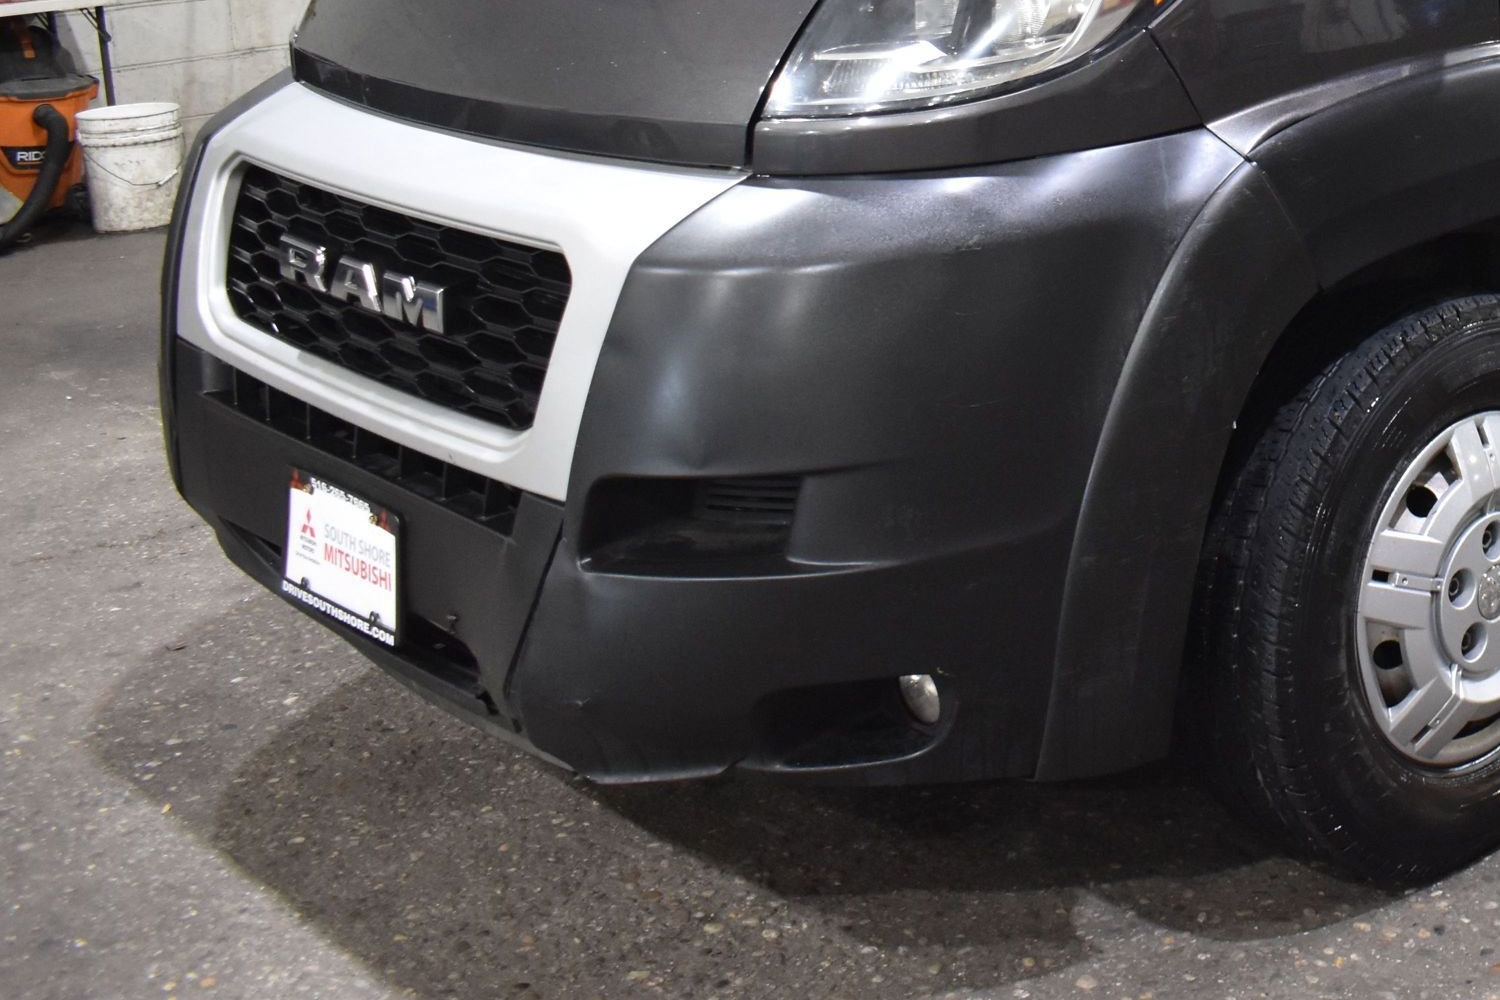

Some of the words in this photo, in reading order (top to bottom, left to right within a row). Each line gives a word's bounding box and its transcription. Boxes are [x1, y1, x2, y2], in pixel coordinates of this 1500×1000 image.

[16, 150, 47, 161] RID
[279, 231, 448, 335] RAM
[323, 522, 357, 548] SOUTH
[358, 539, 391, 568] SHORE
[323, 542, 392, 592] MITSUBISHI
[281, 579, 395, 647] DRIVESOUTHSHORE.COM
